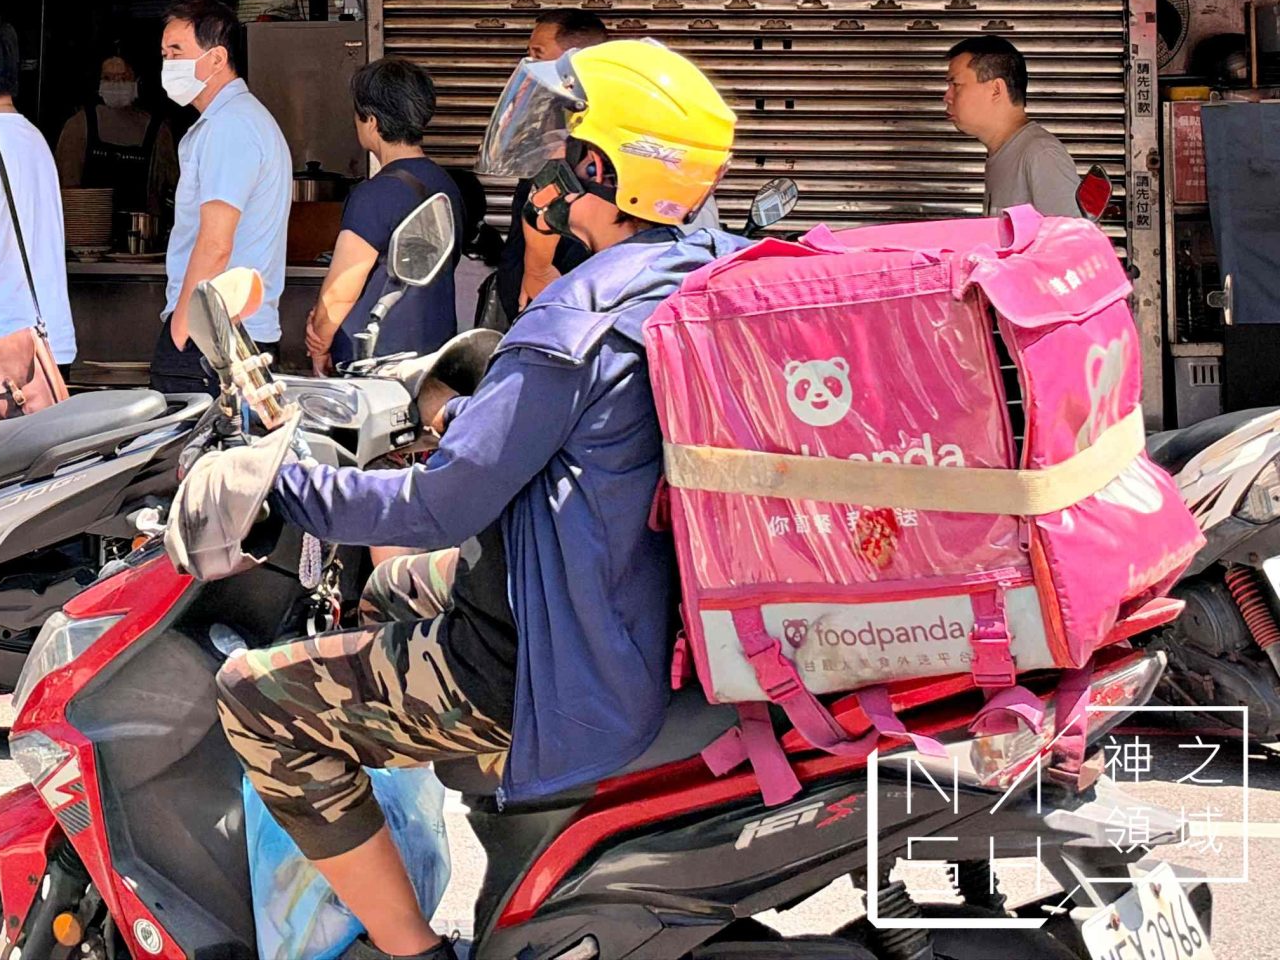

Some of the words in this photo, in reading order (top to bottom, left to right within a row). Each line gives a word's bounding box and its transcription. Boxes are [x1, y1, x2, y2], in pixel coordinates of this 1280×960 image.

[1137, 63, 1151, 114] 請先付款
[1136, 176, 1150, 226] 請先付款
[814, 615, 966, 652] foodpanda
